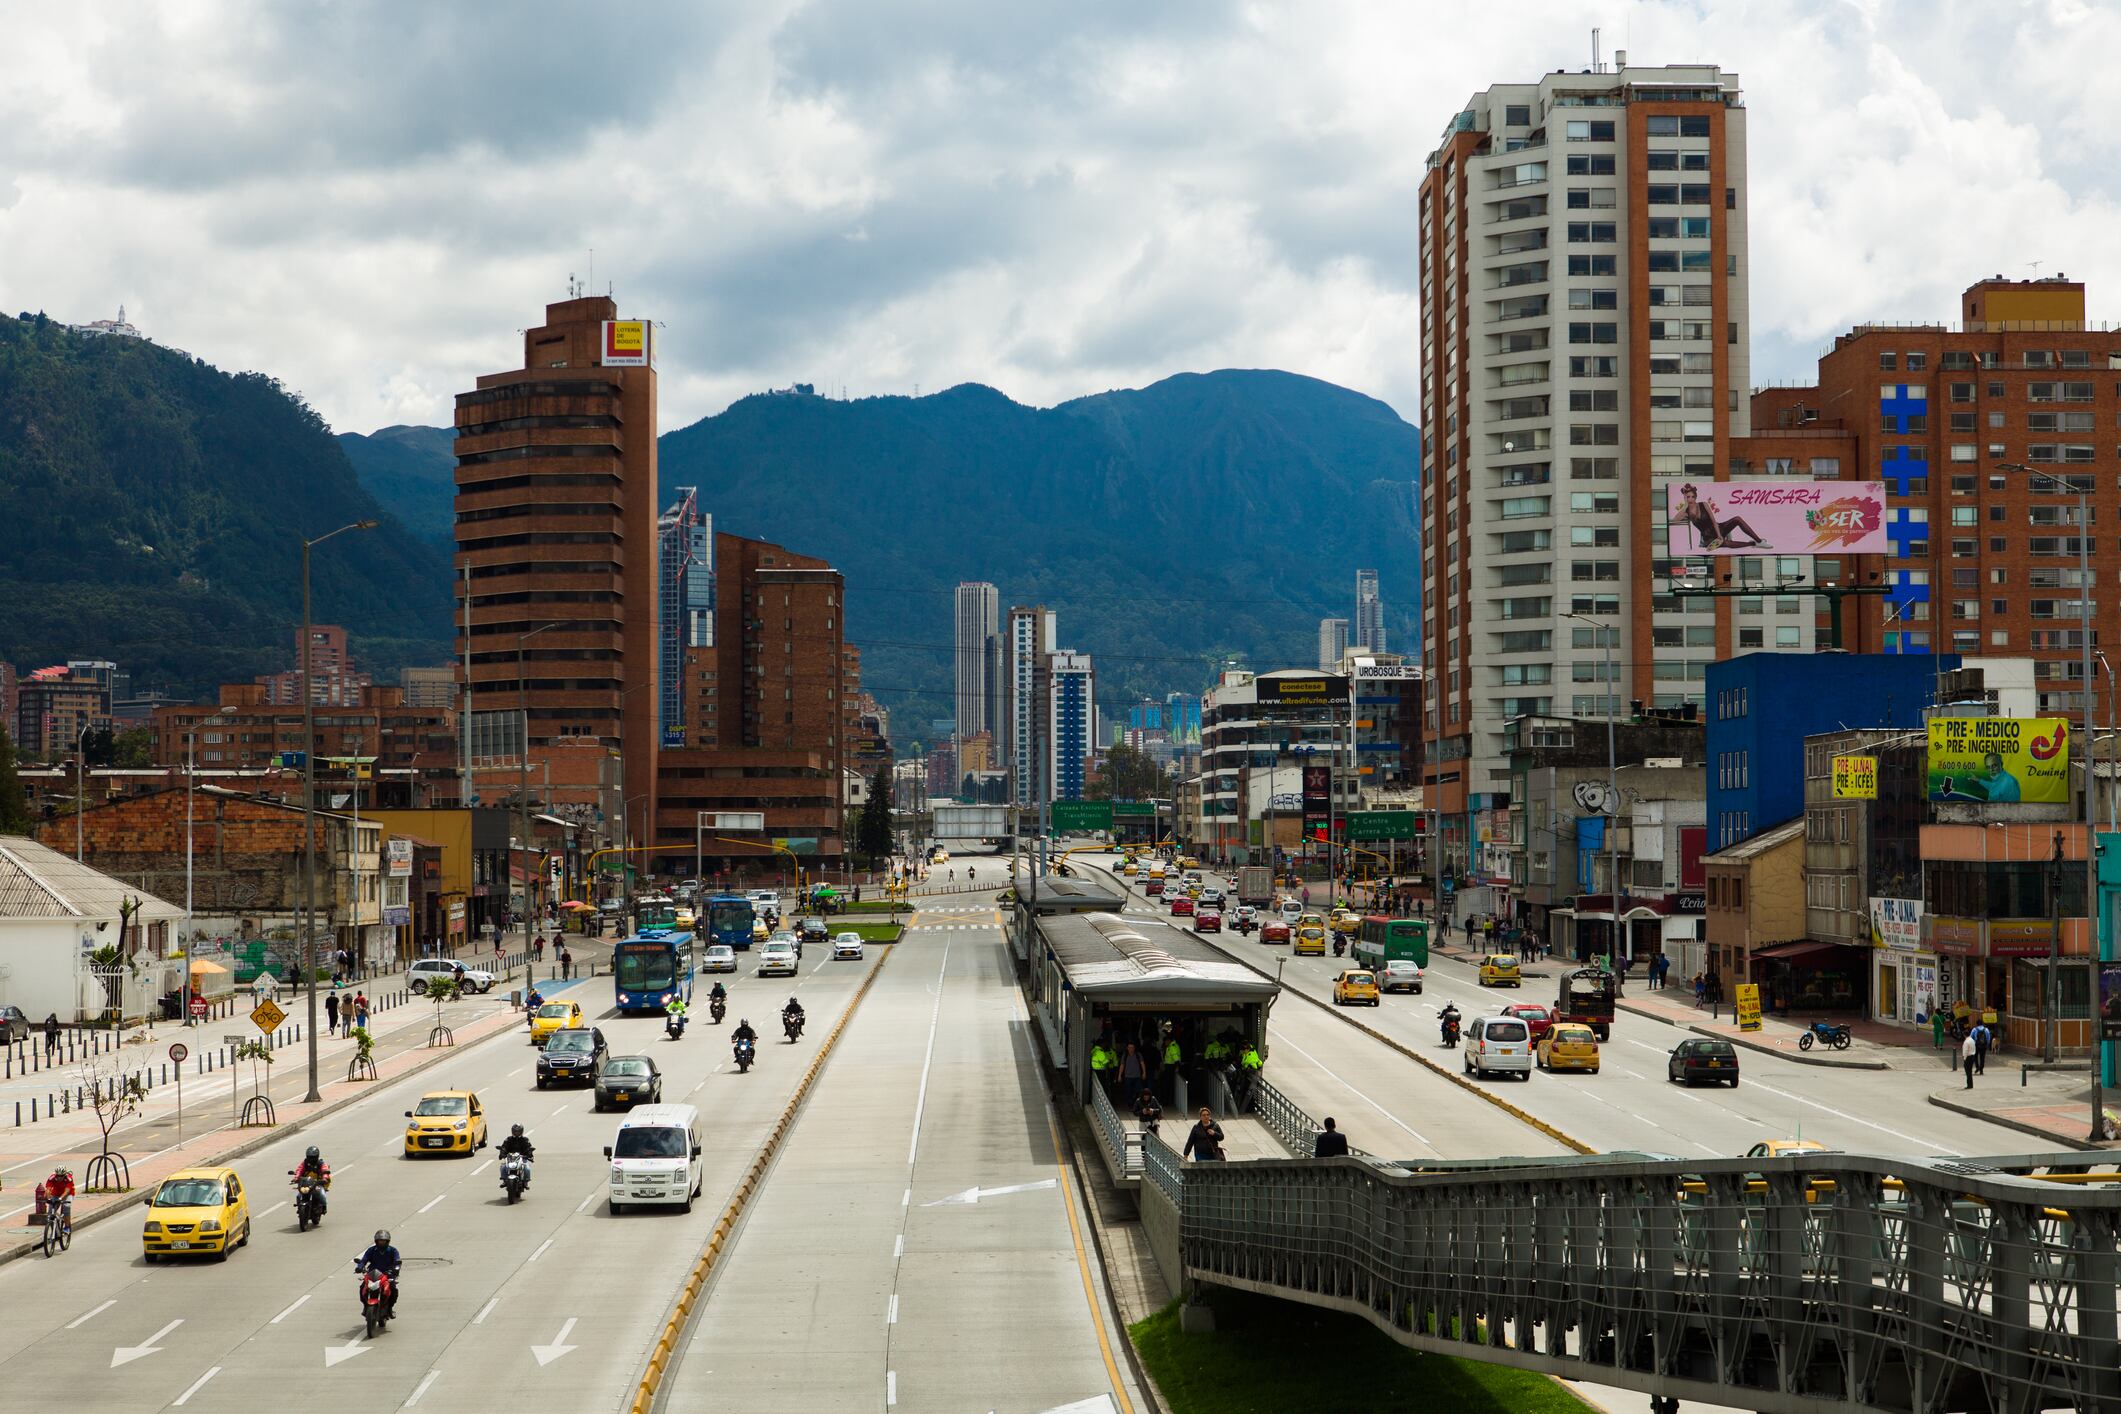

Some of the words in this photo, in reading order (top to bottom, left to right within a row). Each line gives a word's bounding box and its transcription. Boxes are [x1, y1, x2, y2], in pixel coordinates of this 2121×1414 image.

[1729, 489, 1821, 505] SAMSARA
[1829, 509, 1864, 529] SER
[1359, 667, 1402, 677] UROBOSQUE
[1946, 721, 1967, 737] PRE
[1976, 718, 2020, 738] MÉDICO
[1968, 740, 2019, 753] INGENIERO
[1837, 759, 1849, 773] PRE
[1942, 762, 1954, 770] 600
[1963, 762, 1976, 770] 600
[2026, 765, 2066, 779] Deming
[1837, 774, 1848, 788] PRE
[1855, 774, 1873, 788] ICFES
[1352, 827, 1381, 835] Carrera
[1884, 899, 1894, 921] PRE
